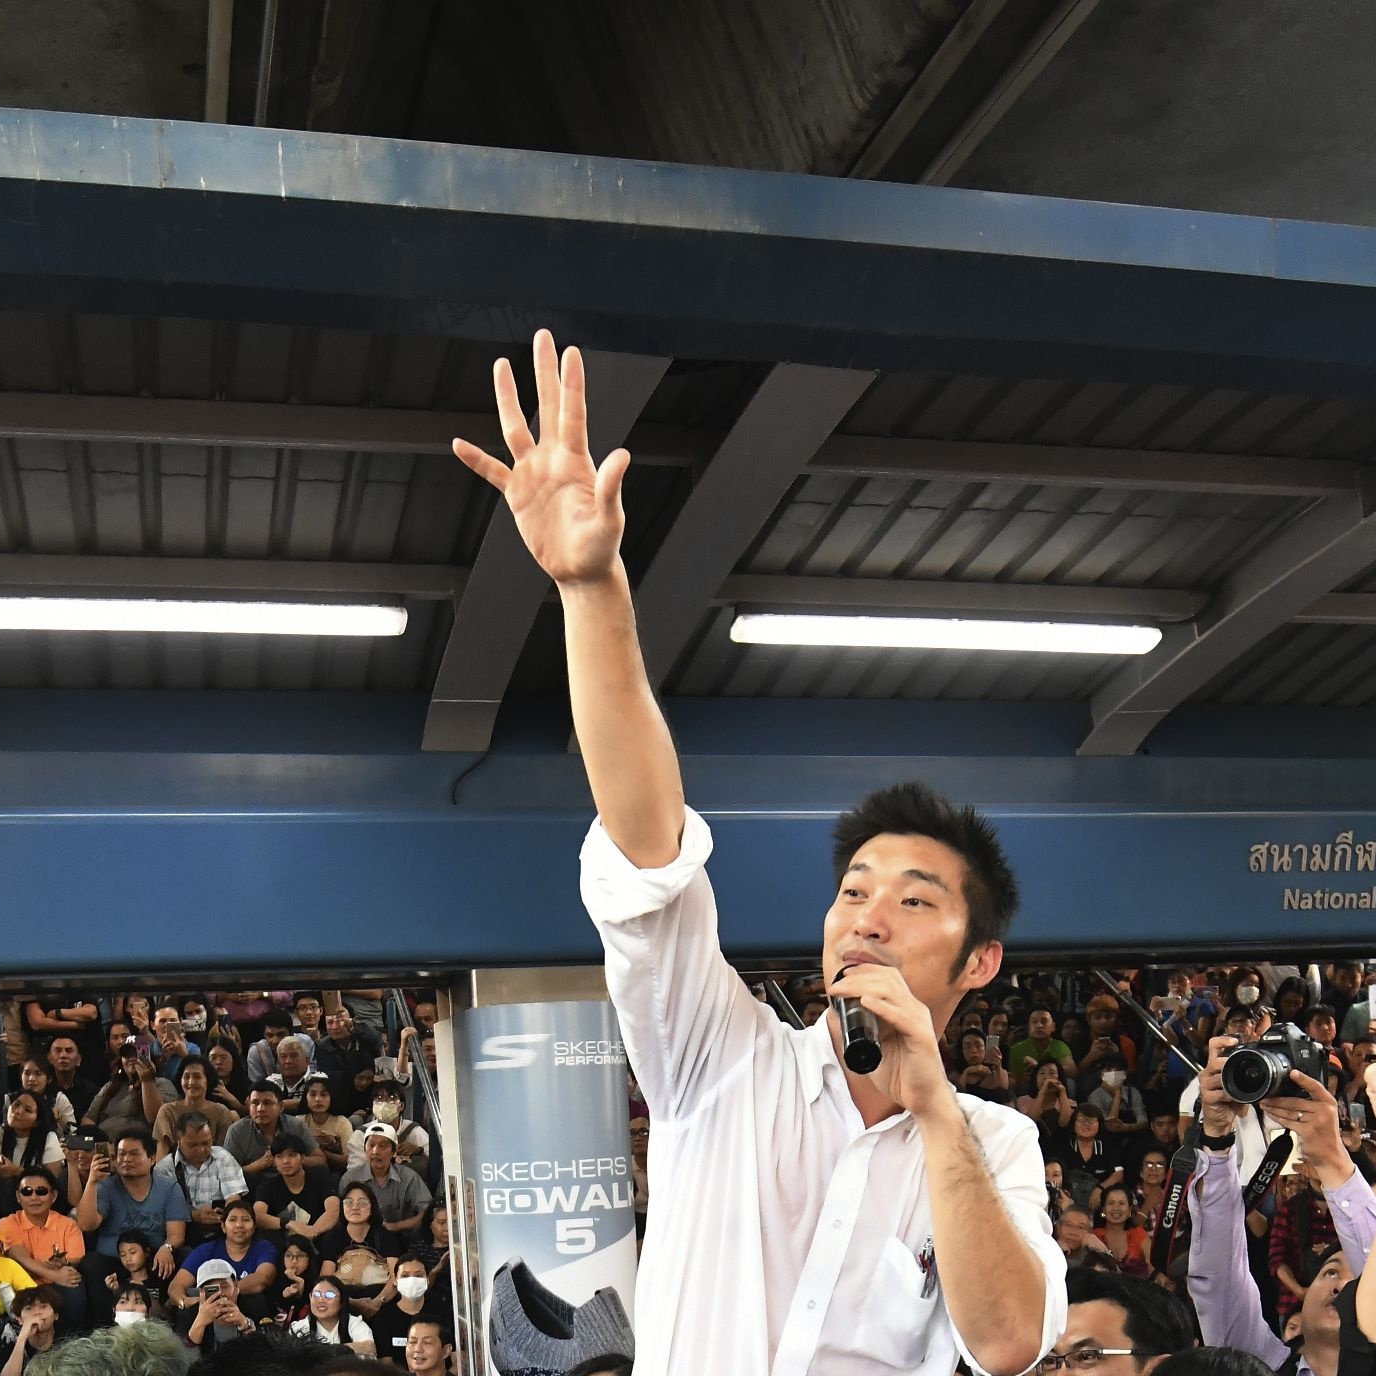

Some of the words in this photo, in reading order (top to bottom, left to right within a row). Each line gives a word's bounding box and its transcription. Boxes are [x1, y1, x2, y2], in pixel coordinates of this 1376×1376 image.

[1283, 886, 1376, 910] National
[555, 1055, 627, 1066] PERFORMA
[481, 1157, 627, 1182] SKECHERS
[1162, 1183, 1183, 1229] Canon
